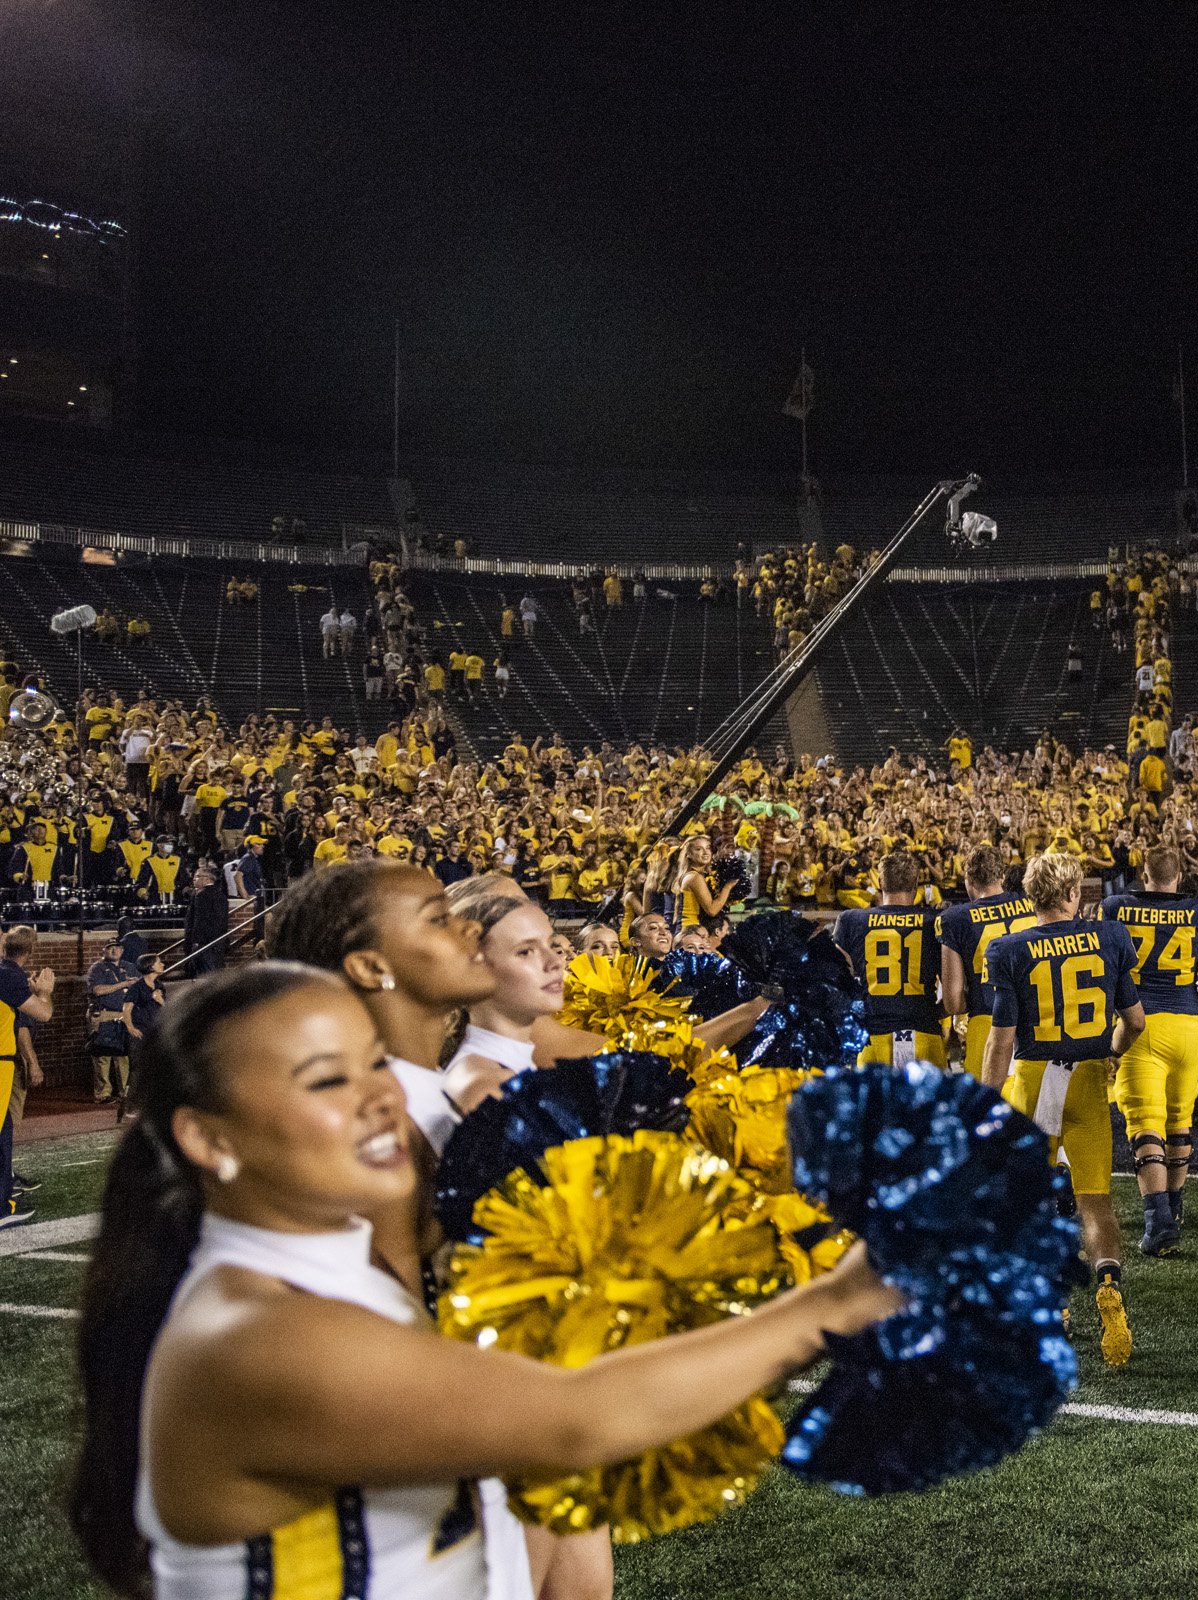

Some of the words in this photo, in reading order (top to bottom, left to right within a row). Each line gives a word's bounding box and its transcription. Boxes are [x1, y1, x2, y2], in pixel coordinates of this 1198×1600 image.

[868, 913, 923, 928] HANSEN
[969, 899, 1034, 923] BEETHAM
[1117, 906, 1195, 924] ATTEBERRY
[1027, 931, 1100, 959] WARREN
[1125, 925, 1197, 986] 74
[864, 929, 925, 996] 81
[1029, 954, 1107, 1042] 16
[895, 1030, 913, 1042] M
